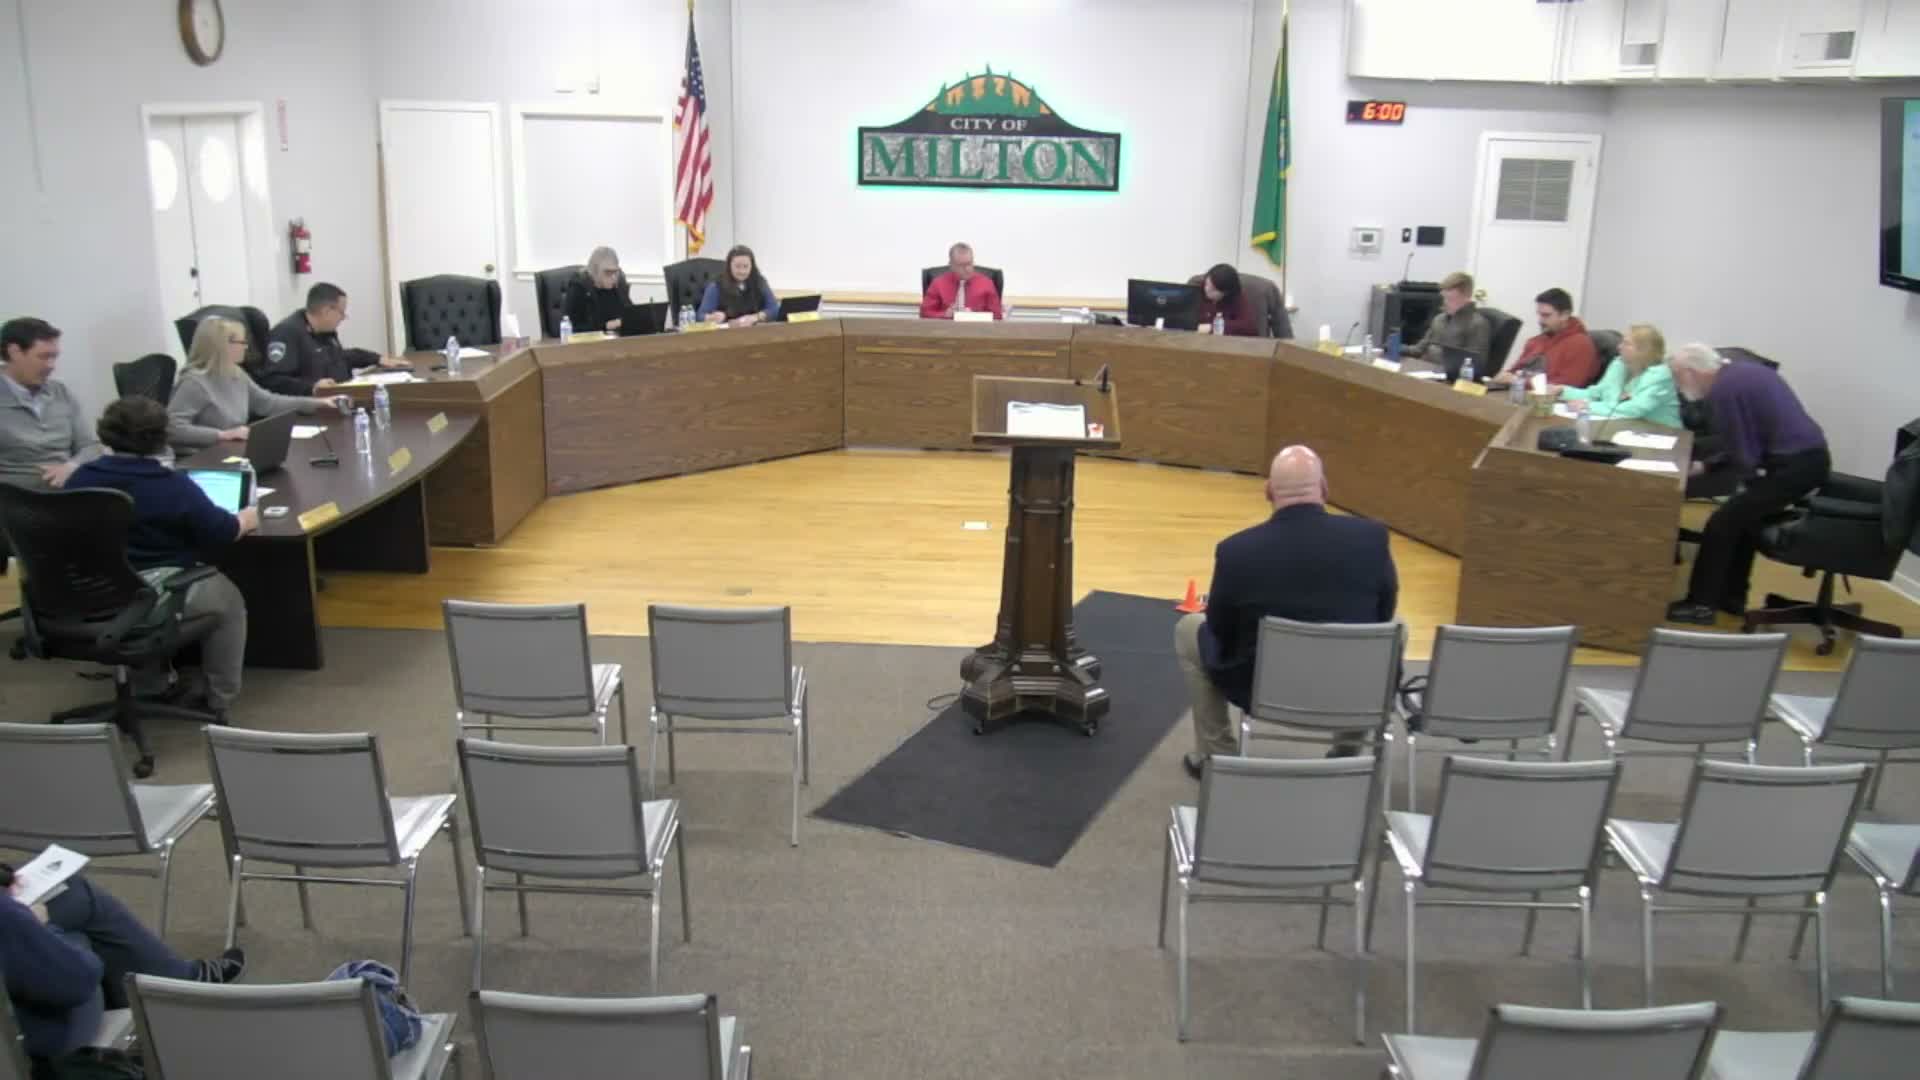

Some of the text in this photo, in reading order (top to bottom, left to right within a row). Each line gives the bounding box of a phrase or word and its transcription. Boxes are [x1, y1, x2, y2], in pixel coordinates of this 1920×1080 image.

[1362, 103, 1405, 120] 6:00
[950, 117, 1028, 131] CITY OF
[866, 135, 1114, 182] MILTON
